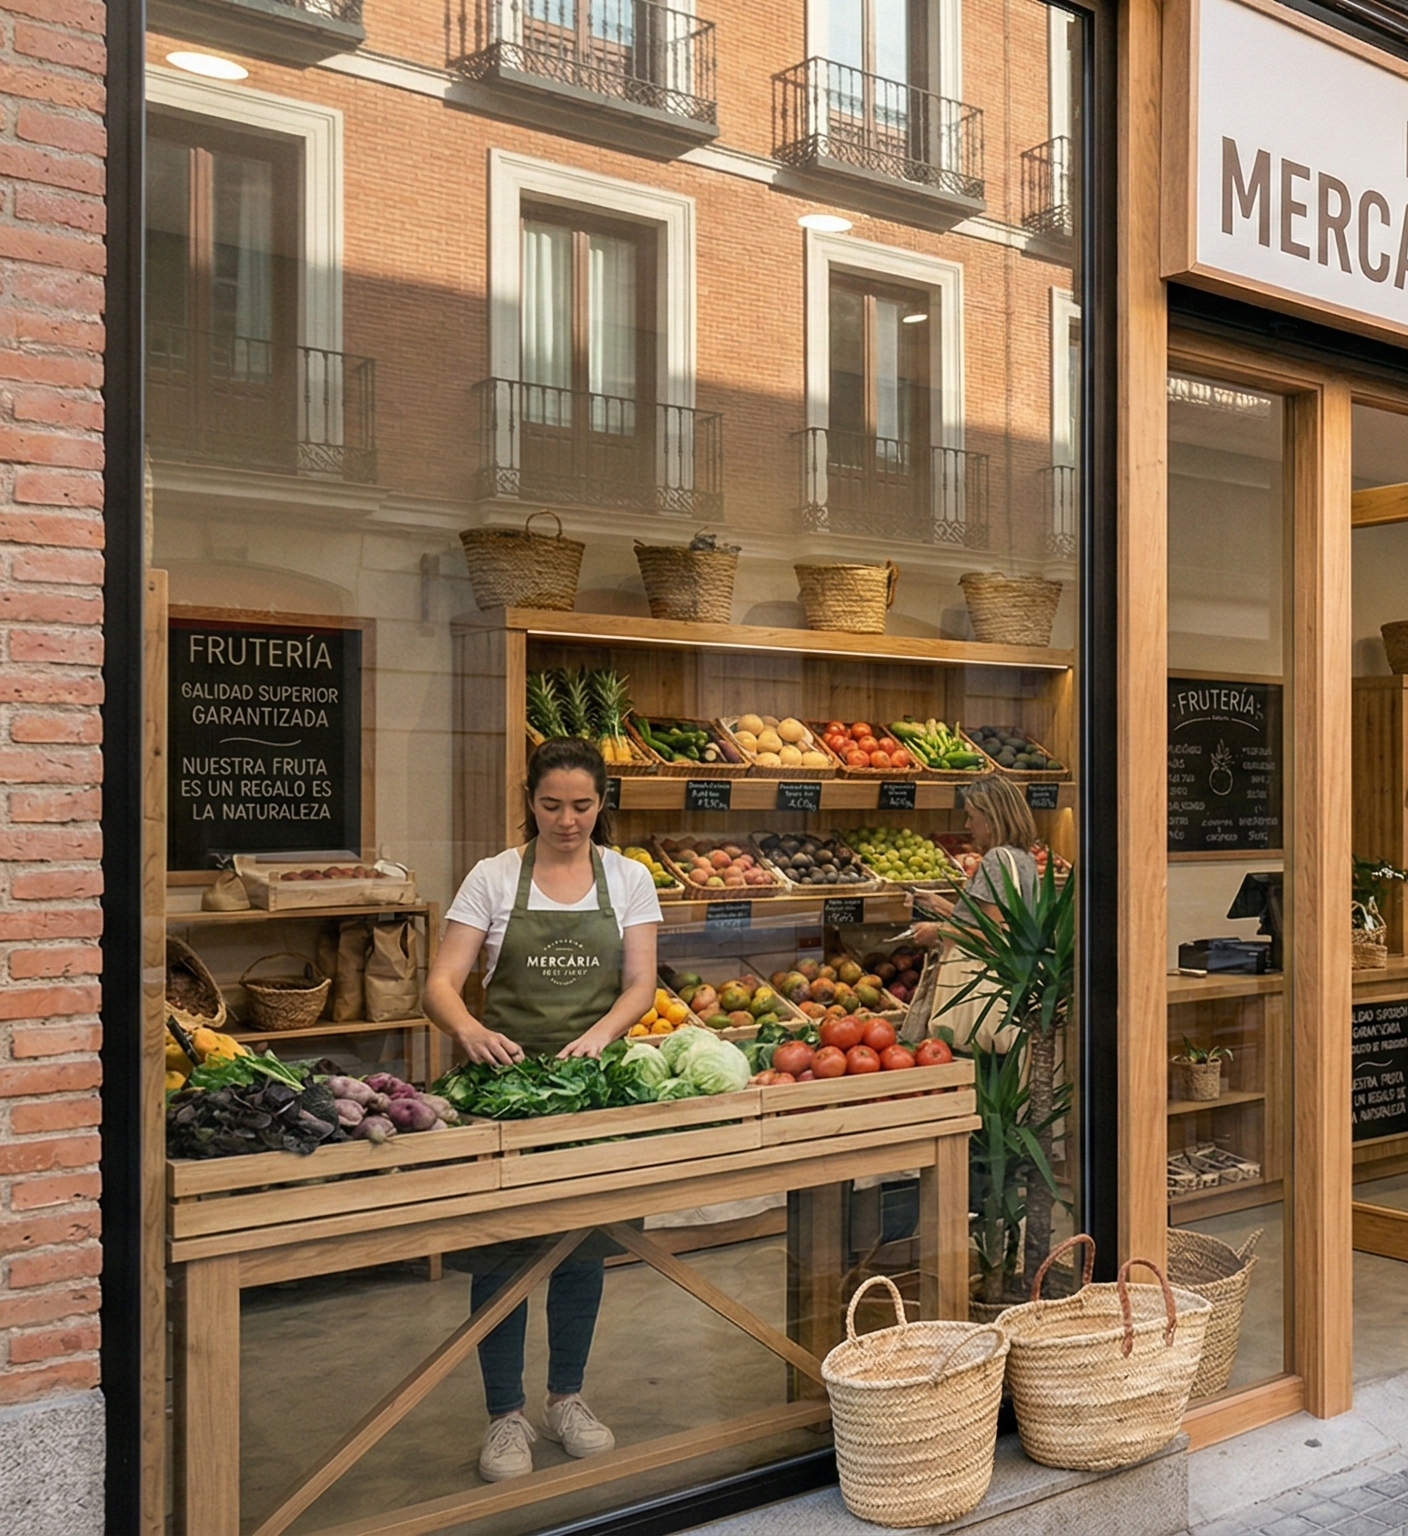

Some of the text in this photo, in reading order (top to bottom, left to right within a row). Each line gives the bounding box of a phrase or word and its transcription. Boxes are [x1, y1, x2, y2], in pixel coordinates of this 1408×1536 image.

[188, 634, 333, 670] FRUTERÍA
[258, 685, 339, 704] SUPERIOR
[1177, 687, 1255, 716] FRUTERÍA
[192, 705, 330, 728] GARANTIZADA
[182, 757, 328, 776] NUESTRA FRUTA
[180, 780, 332, 797] ES UN REGALO ES
[192, 803, 332, 821] LA NATURALEZA
